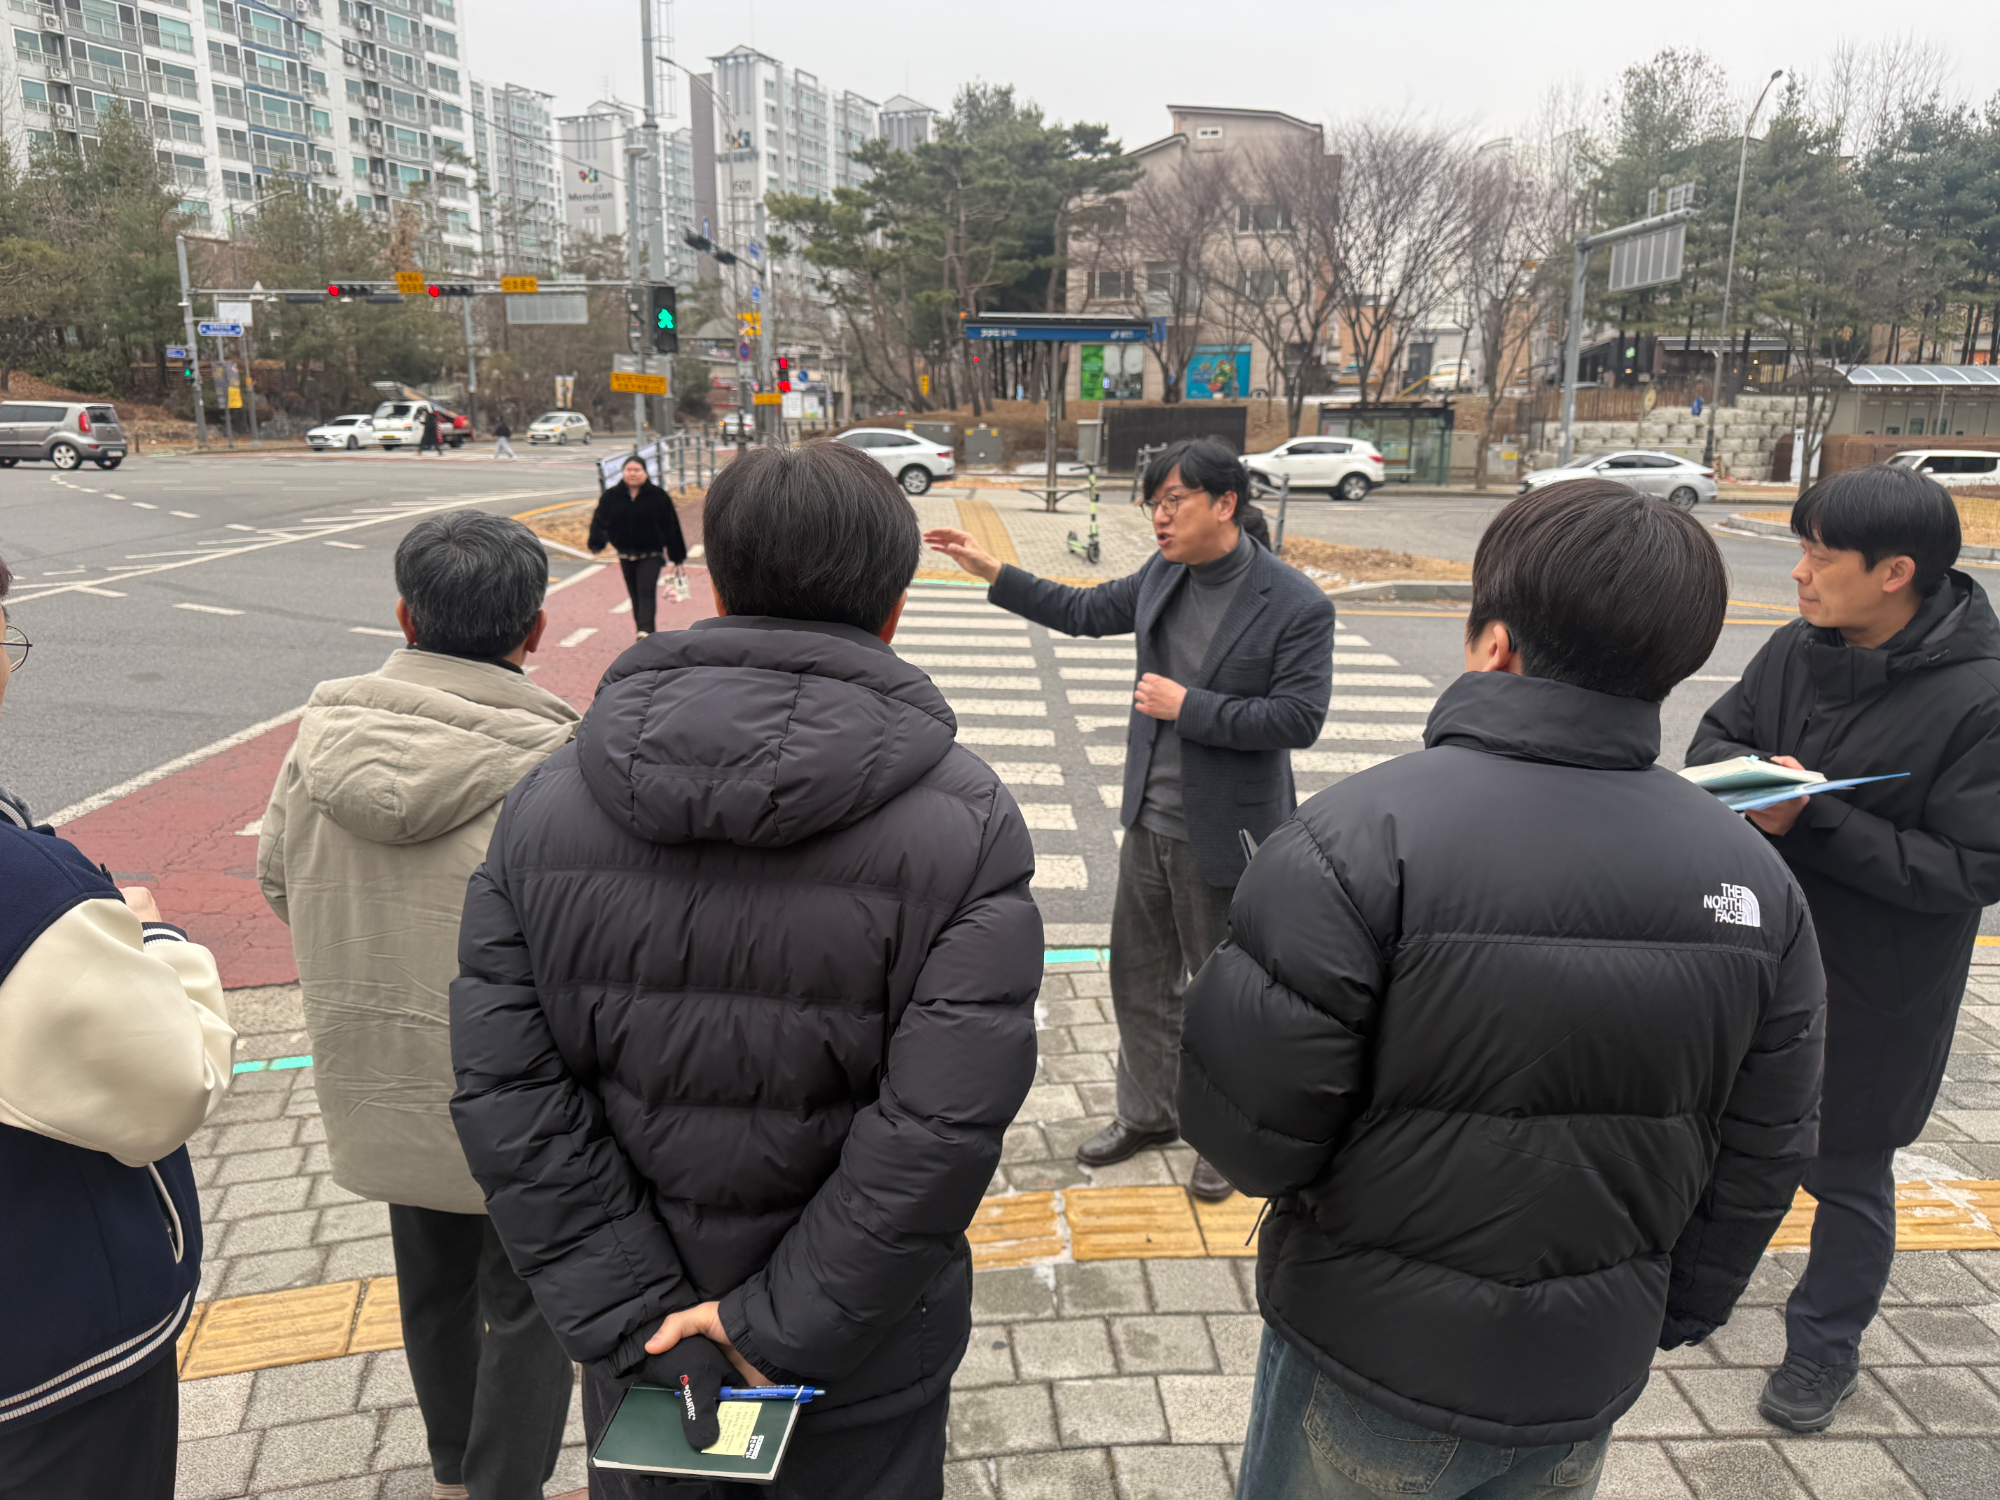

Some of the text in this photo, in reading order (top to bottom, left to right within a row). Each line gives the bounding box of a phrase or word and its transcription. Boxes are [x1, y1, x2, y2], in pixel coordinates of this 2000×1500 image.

[1721, 883, 1742, 898] THE
[1703, 895, 1742, 911] NORTH
[1715, 910, 1743, 925] FACE
